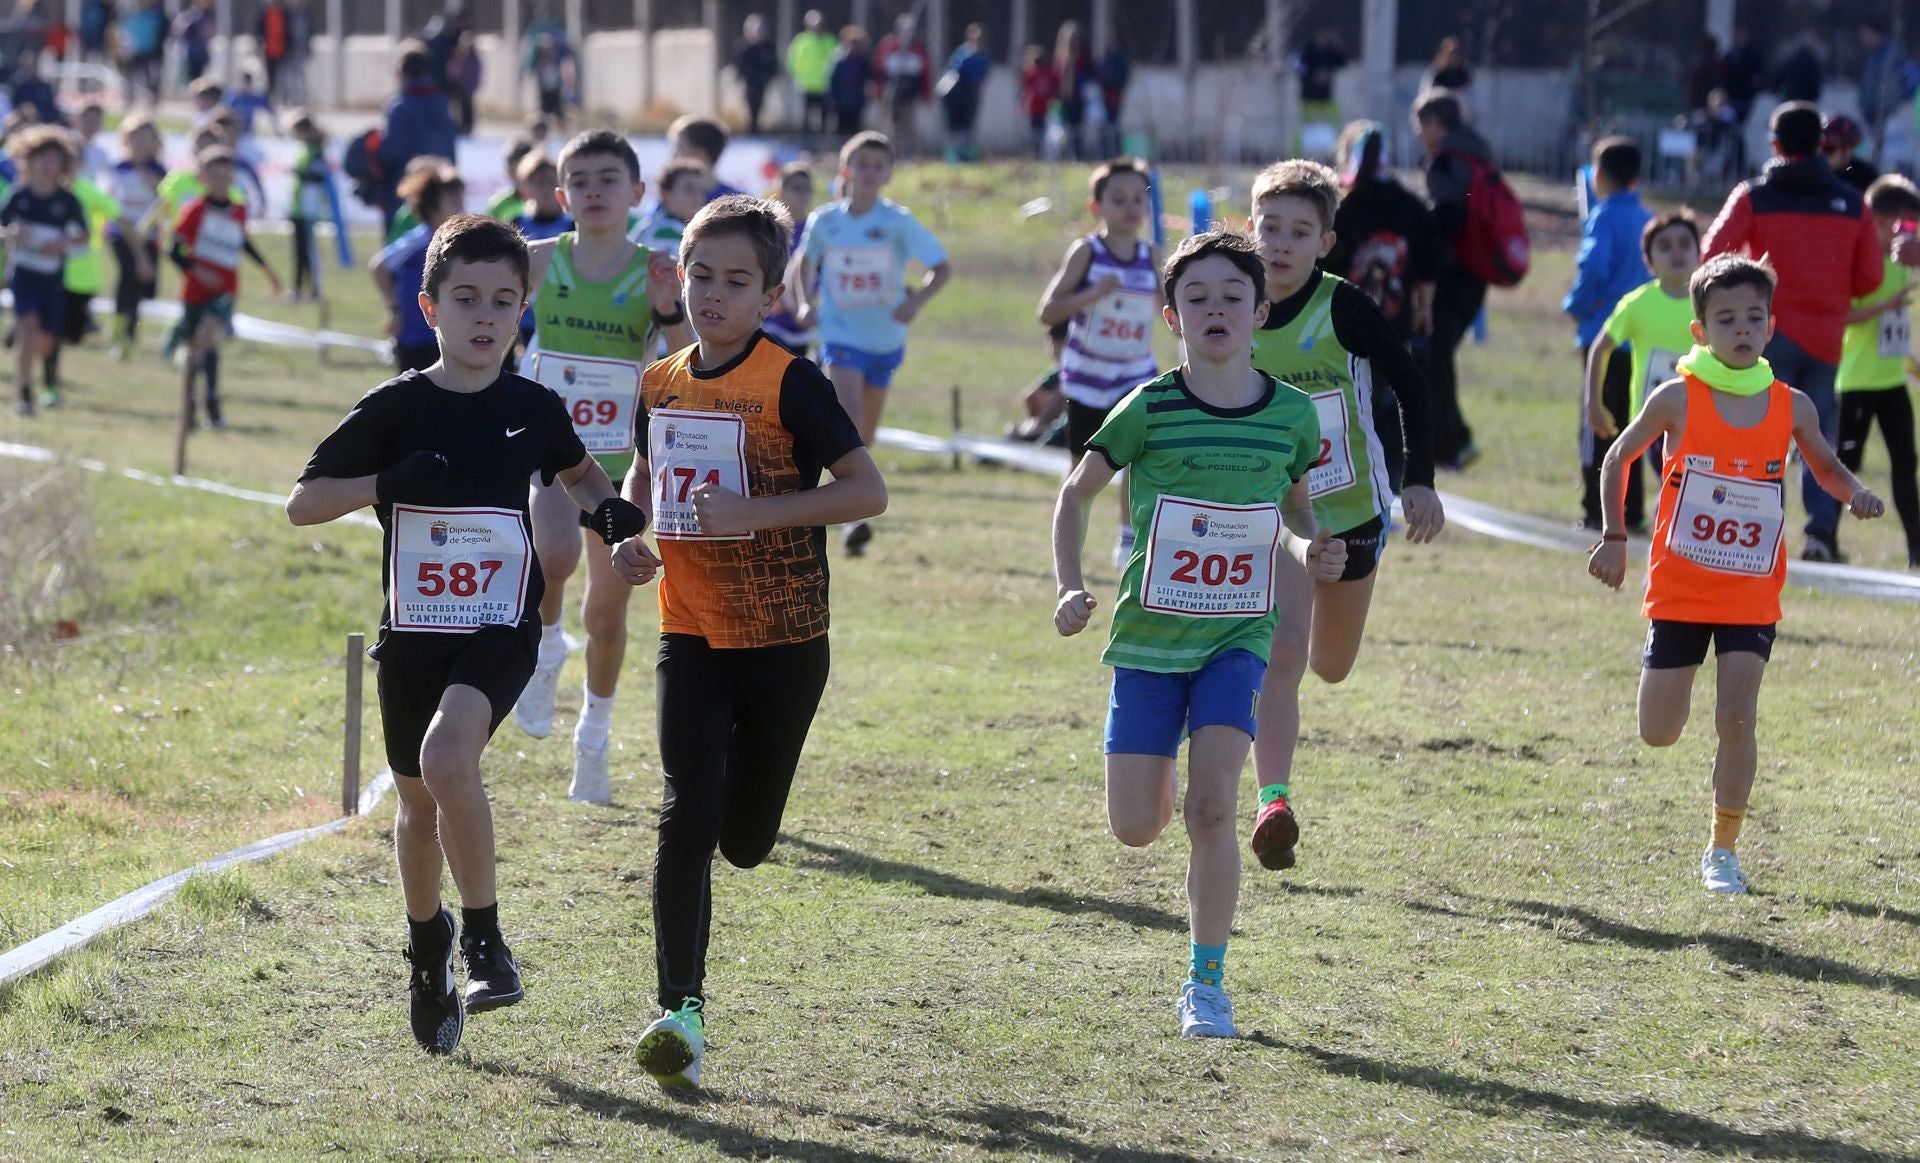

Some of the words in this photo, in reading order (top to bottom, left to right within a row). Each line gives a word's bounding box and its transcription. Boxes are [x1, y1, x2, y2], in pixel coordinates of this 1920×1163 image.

[546, 313, 560, 325] LA
[565, 317, 624, 335] GRANJA
[562, 397, 618, 426] 69
[675, 441, 685, 450] de
[685, 441, 708, 451] Segovia
[1316, 438, 1332, 467] 2
[1208, 464, 1248, 472] POZUELO
[449, 526, 492, 536] Diputación
[1210, 521, 1249, 531] Diputación
[1691, 513, 1763, 548] 963
[449, 536, 460, 545] de
[461, 535, 491, 546] Segovia
[1220, 530, 1247, 540] Segovia
[1169, 550, 1254, 586] 205
[417, 560, 503, 597] 587
[1157, 586, 1174, 597] LIII
[1176, 589, 1204, 600] CROSS
[1206, 591, 1248, 601] NACIONAL
[1250, 591, 1261, 599] DE
[406, 604, 424, 612] LIII
[426, 604, 456, 613] CROSS
[497, 603, 509, 611] DE
[1157, 597, 1228, 611] CANTIMPALOS
[1235, 601, 1257, 610] 2025
[480, 612, 505, 622] 2025
